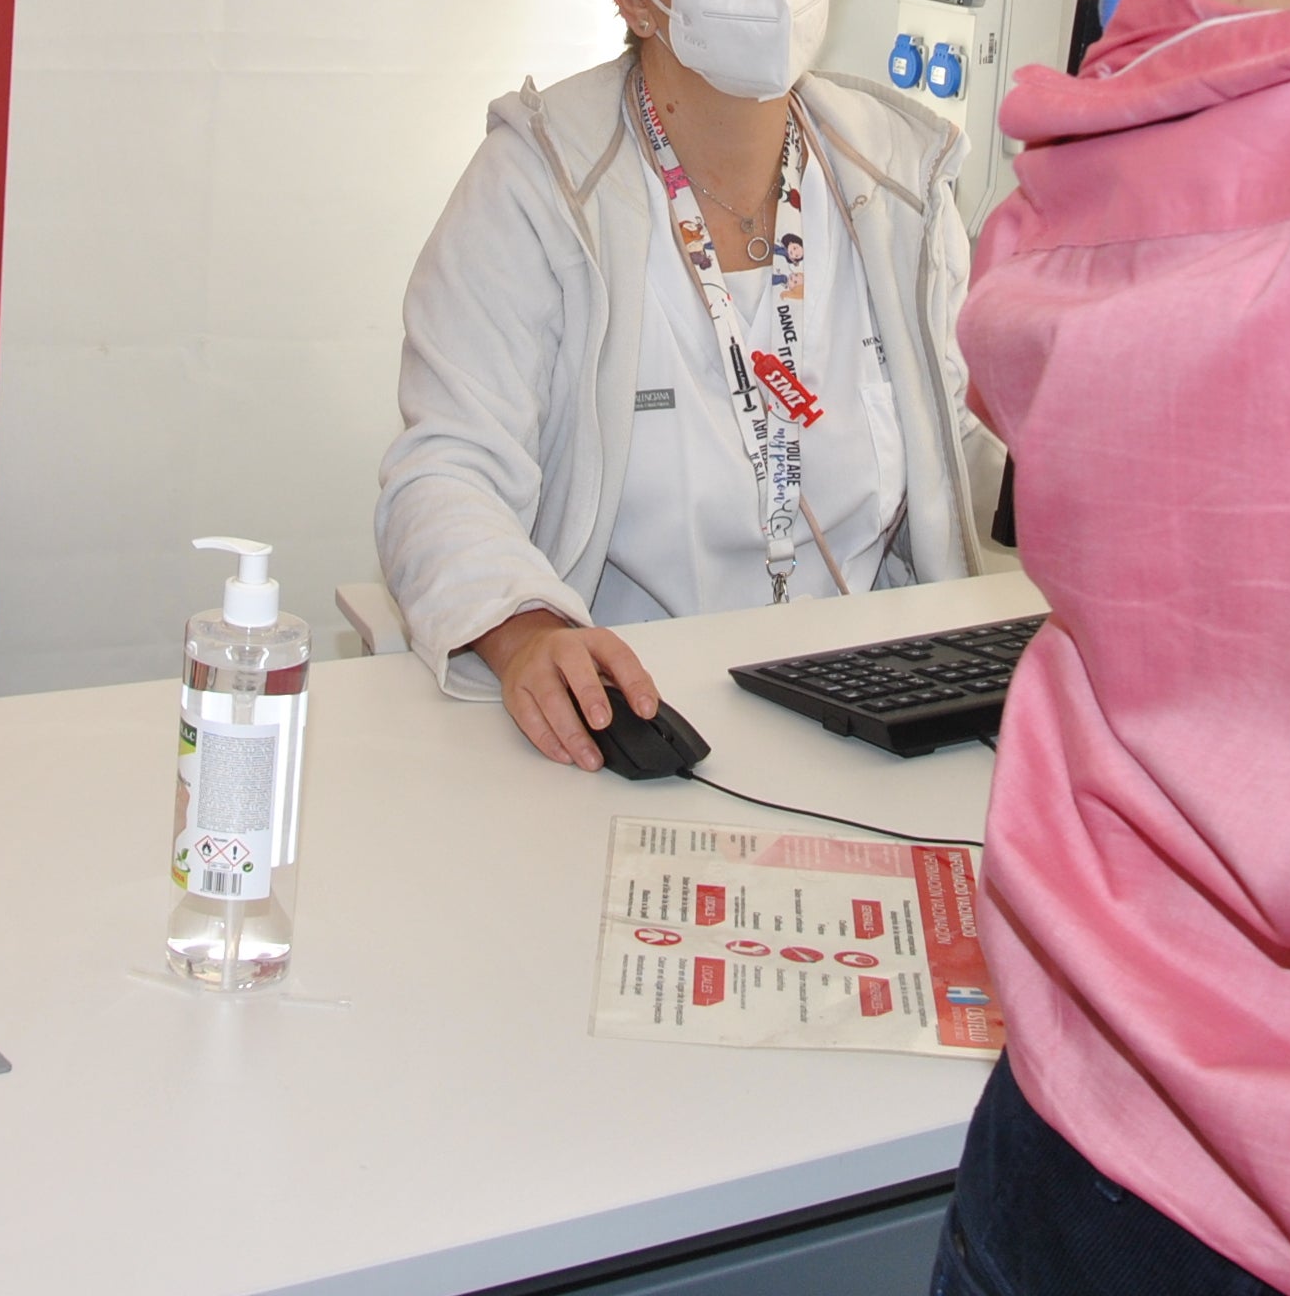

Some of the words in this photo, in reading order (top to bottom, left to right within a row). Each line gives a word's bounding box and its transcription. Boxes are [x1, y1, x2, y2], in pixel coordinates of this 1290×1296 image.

[777, 304, 797, 345] DANCE
[778, 346, 791, 357] IT
[769, 428, 786, 449] my
[786, 439, 800, 461] YOU
[769, 454, 786, 503] person
[786, 464, 801, 487] ARE
[701, 965, 713, 994] LOCALES
[965, 1007, 993, 1042] CASTELLÓ
